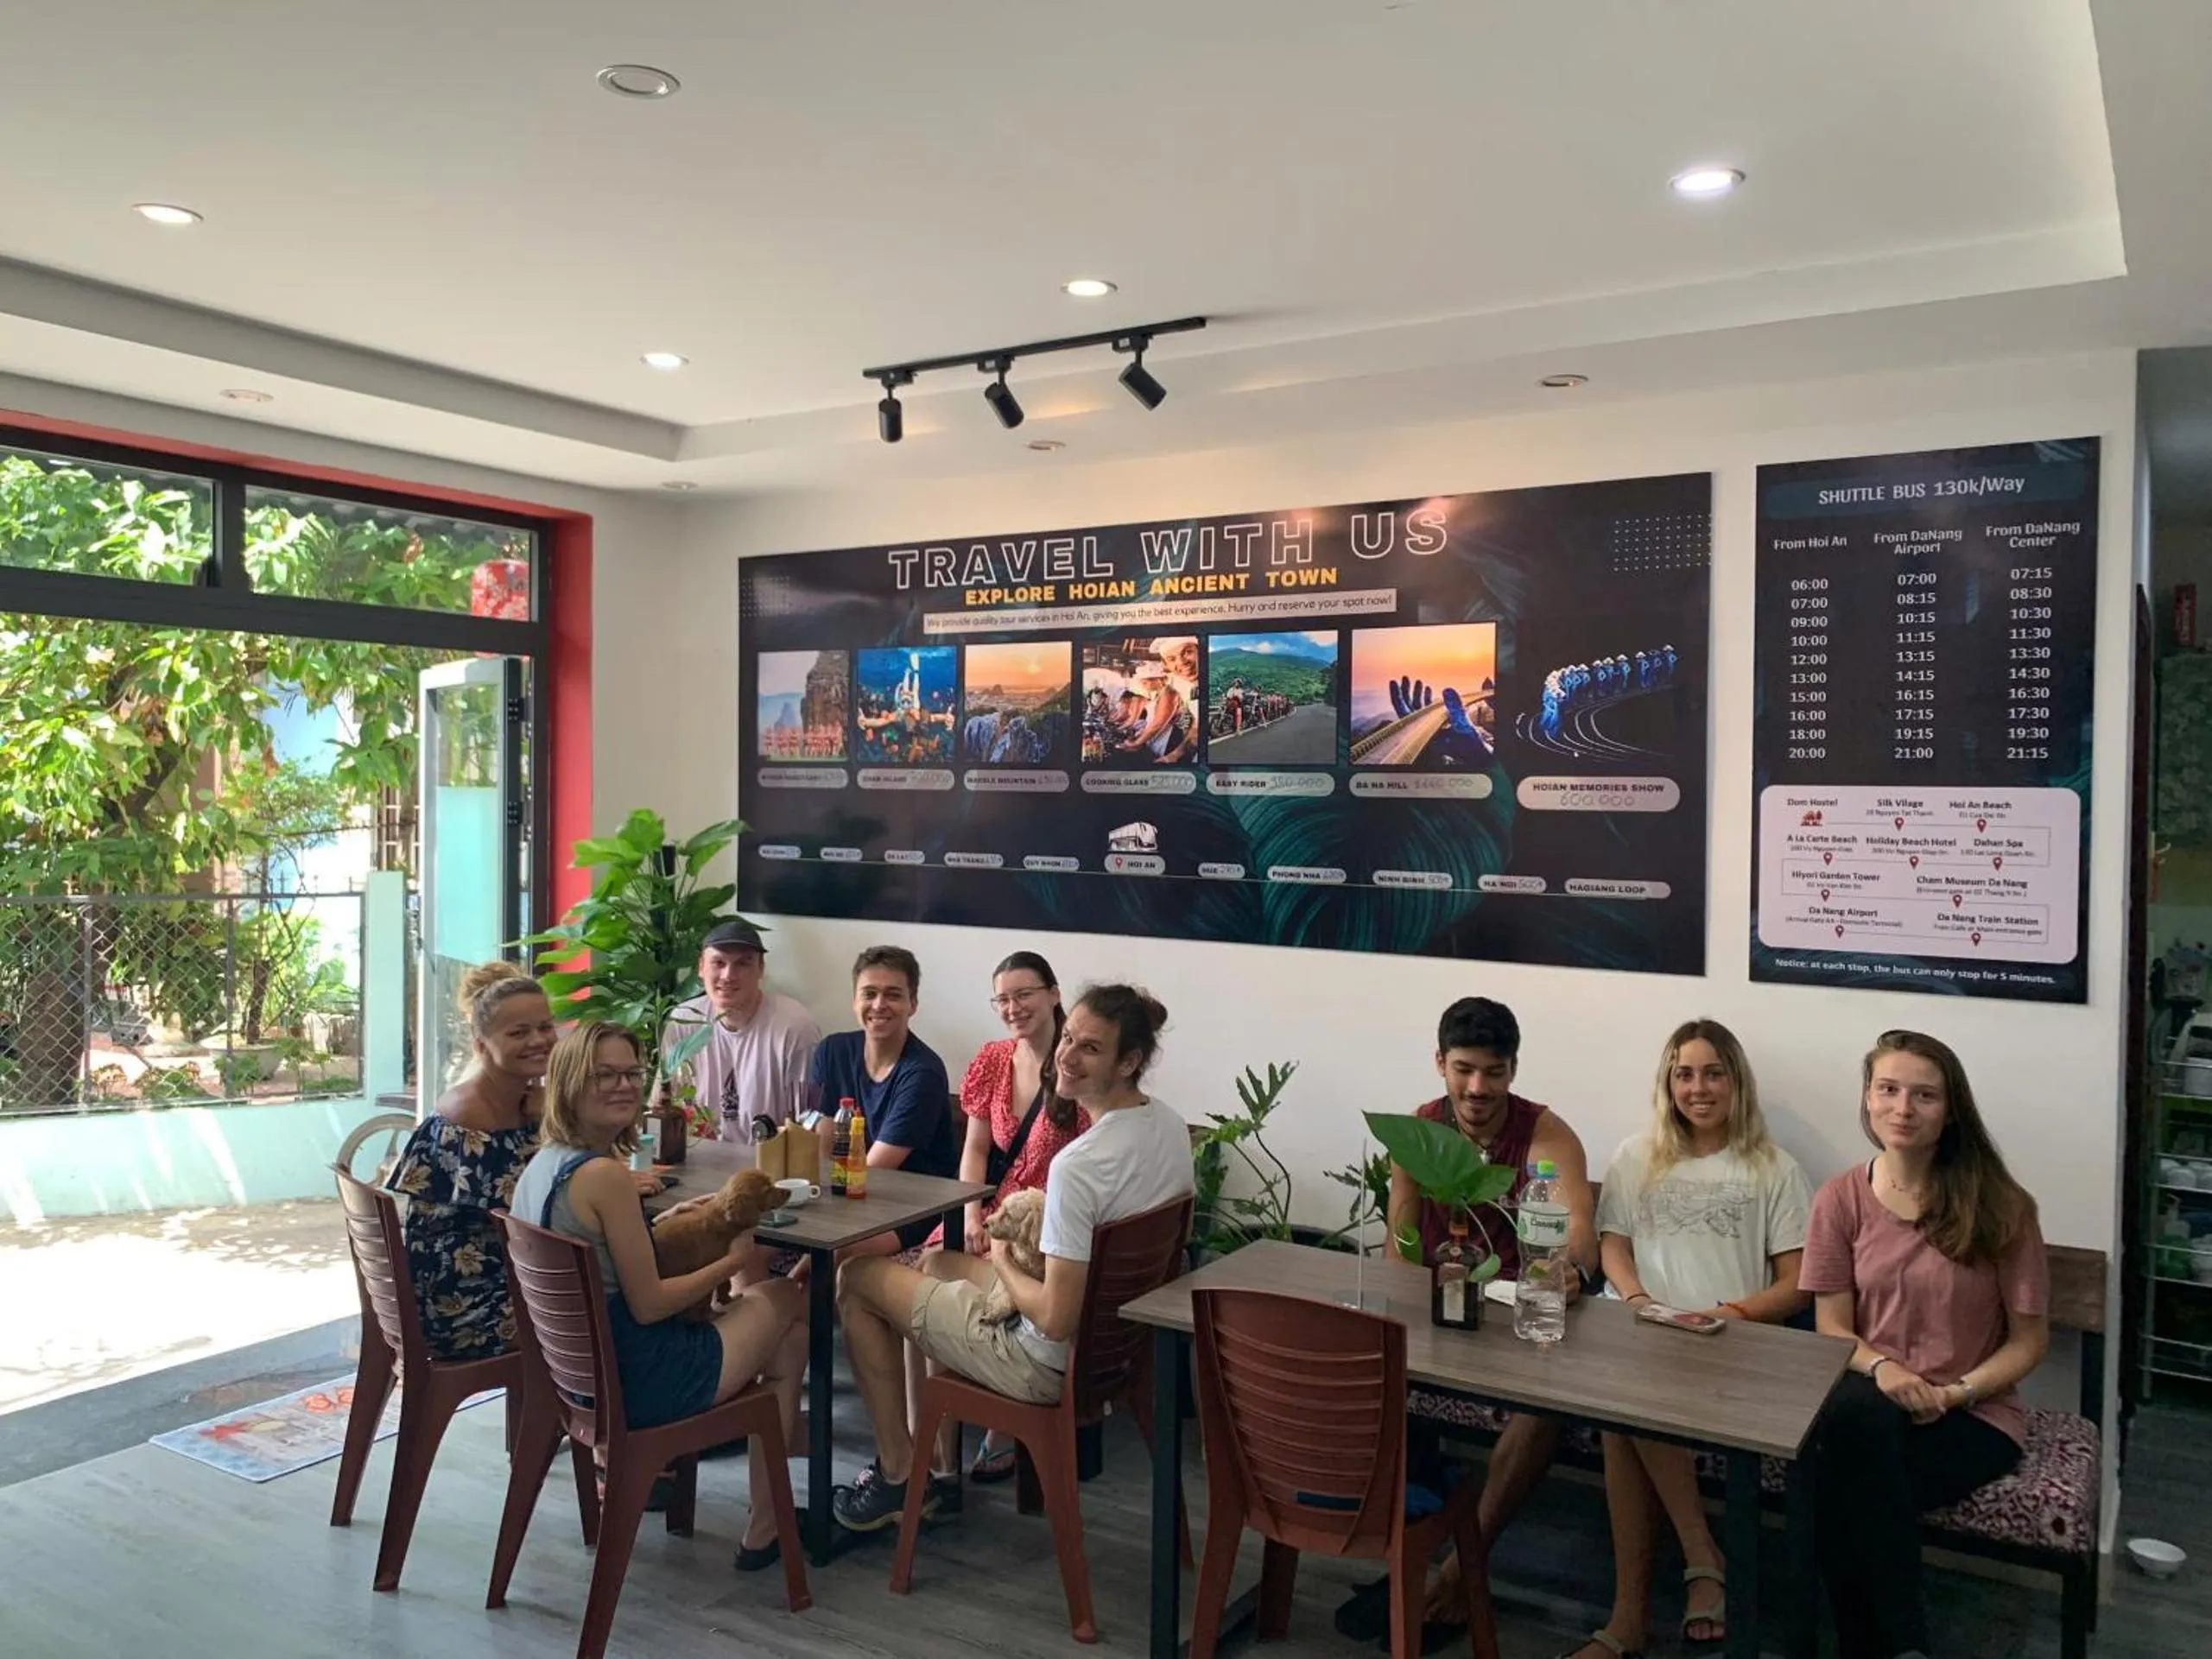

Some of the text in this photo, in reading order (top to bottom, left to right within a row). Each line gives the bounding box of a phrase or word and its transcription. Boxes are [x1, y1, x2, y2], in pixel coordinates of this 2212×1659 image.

[1819, 476, 2025, 505] SHUTTLE BUS 130k/Way
[1986, 521, 2081, 536] From DaNang
[1774, 535, 1848, 550] From Hoi An
[1874, 529, 1962, 544] From DaNang
[2009, 535, 2057, 548] Center
[889, 508, 1448, 589] TRAVEL WITH US
[1894, 542, 1941, 556] Airport
[1898, 573, 1936, 585] 07:00
[2011, 567, 2052, 579] 07:15
[965, 567, 1337, 605] EXPLORE HOIAN ANCIENT TOWN
[1791, 579, 1829, 590] 06:00
[1897, 592, 1936, 604] 08:15
[2011, 588, 2051, 599] 08:30
[1791, 598, 1828, 609] 07:00
[941, 617, 971, 629] provide
[973, 616, 998, 627] quality
[1018, 614, 1050, 623] services
[1093, 610, 1119, 622] giving
[1120, 611, 1136, 619] you
[1138, 608, 1151, 617] the
[1154, 605, 1172, 615] best
[1228, 602, 1256, 616] Hurry
[1258, 600, 1277, 611] and
[1278, 600, 1315, 611] reserve
[1318, 598, 1340, 611] your
[1342, 598, 1364, 608] spot
[1366, 595, 1391, 605] now!
[1897, 612, 1936, 624] 10:15
[2010, 608, 2051, 619] 10:30
[1791, 616, 1828, 628] 09:00
[1896, 631, 1936, 643] 11:15
[2010, 628, 2051, 639] 11:30
[1791, 635, 1828, 647] 10:00
[1790, 654, 1828, 665] 12:00
[1896, 651, 1935, 662] 13:15
[2009, 648, 2050, 659] 13:30
[1790, 672, 1827, 684] 13:00
[1896, 670, 1935, 682] 14:15
[2009, 668, 2050, 679] 14:30
[1790, 691, 1827, 703] 15:00
[1895, 690, 1935, 701] 16:15
[2008, 687, 2050, 700] 16:30
[1790, 710, 1827, 721] 16:00
[1895, 709, 1934, 720] 17:15
[2008, 707, 2050, 719] 17:30
[1789, 729, 1826, 740] 18:00
[1895, 728, 1934, 739] 19:15
[2008, 727, 2049, 739] 19:30
[1789, 747, 1826, 759] 20:00
[1894, 747, 1934, 759] 21:00
[2007, 747, 2049, 759] 21:15
[1533, 782, 1567, 791] HOIAN
[1570, 783, 1628, 792] MEMORIES
[1867, 837, 1899, 846] Holiday
[1903, 837, 1929, 847] Beach
[2006, 839, 2023, 848] Spa
[1853, 872, 1879, 881] Tower
[1945, 877, 1986, 886] Museum
[1988, 878, 2001, 887] Da
[2003, 879, 2028, 889] Nang
[1619, 885, 1646, 894] LOOP
[1823, 907, 1844, 916] Nang
[1848, 908, 1878, 917] Airport
[1952, 915, 1975, 923] Nang
[2005, 916, 2038, 925] Station
[1775, 959, 2056, 984] Notice: at each stop, the bus can only stop for 5 minutes.
